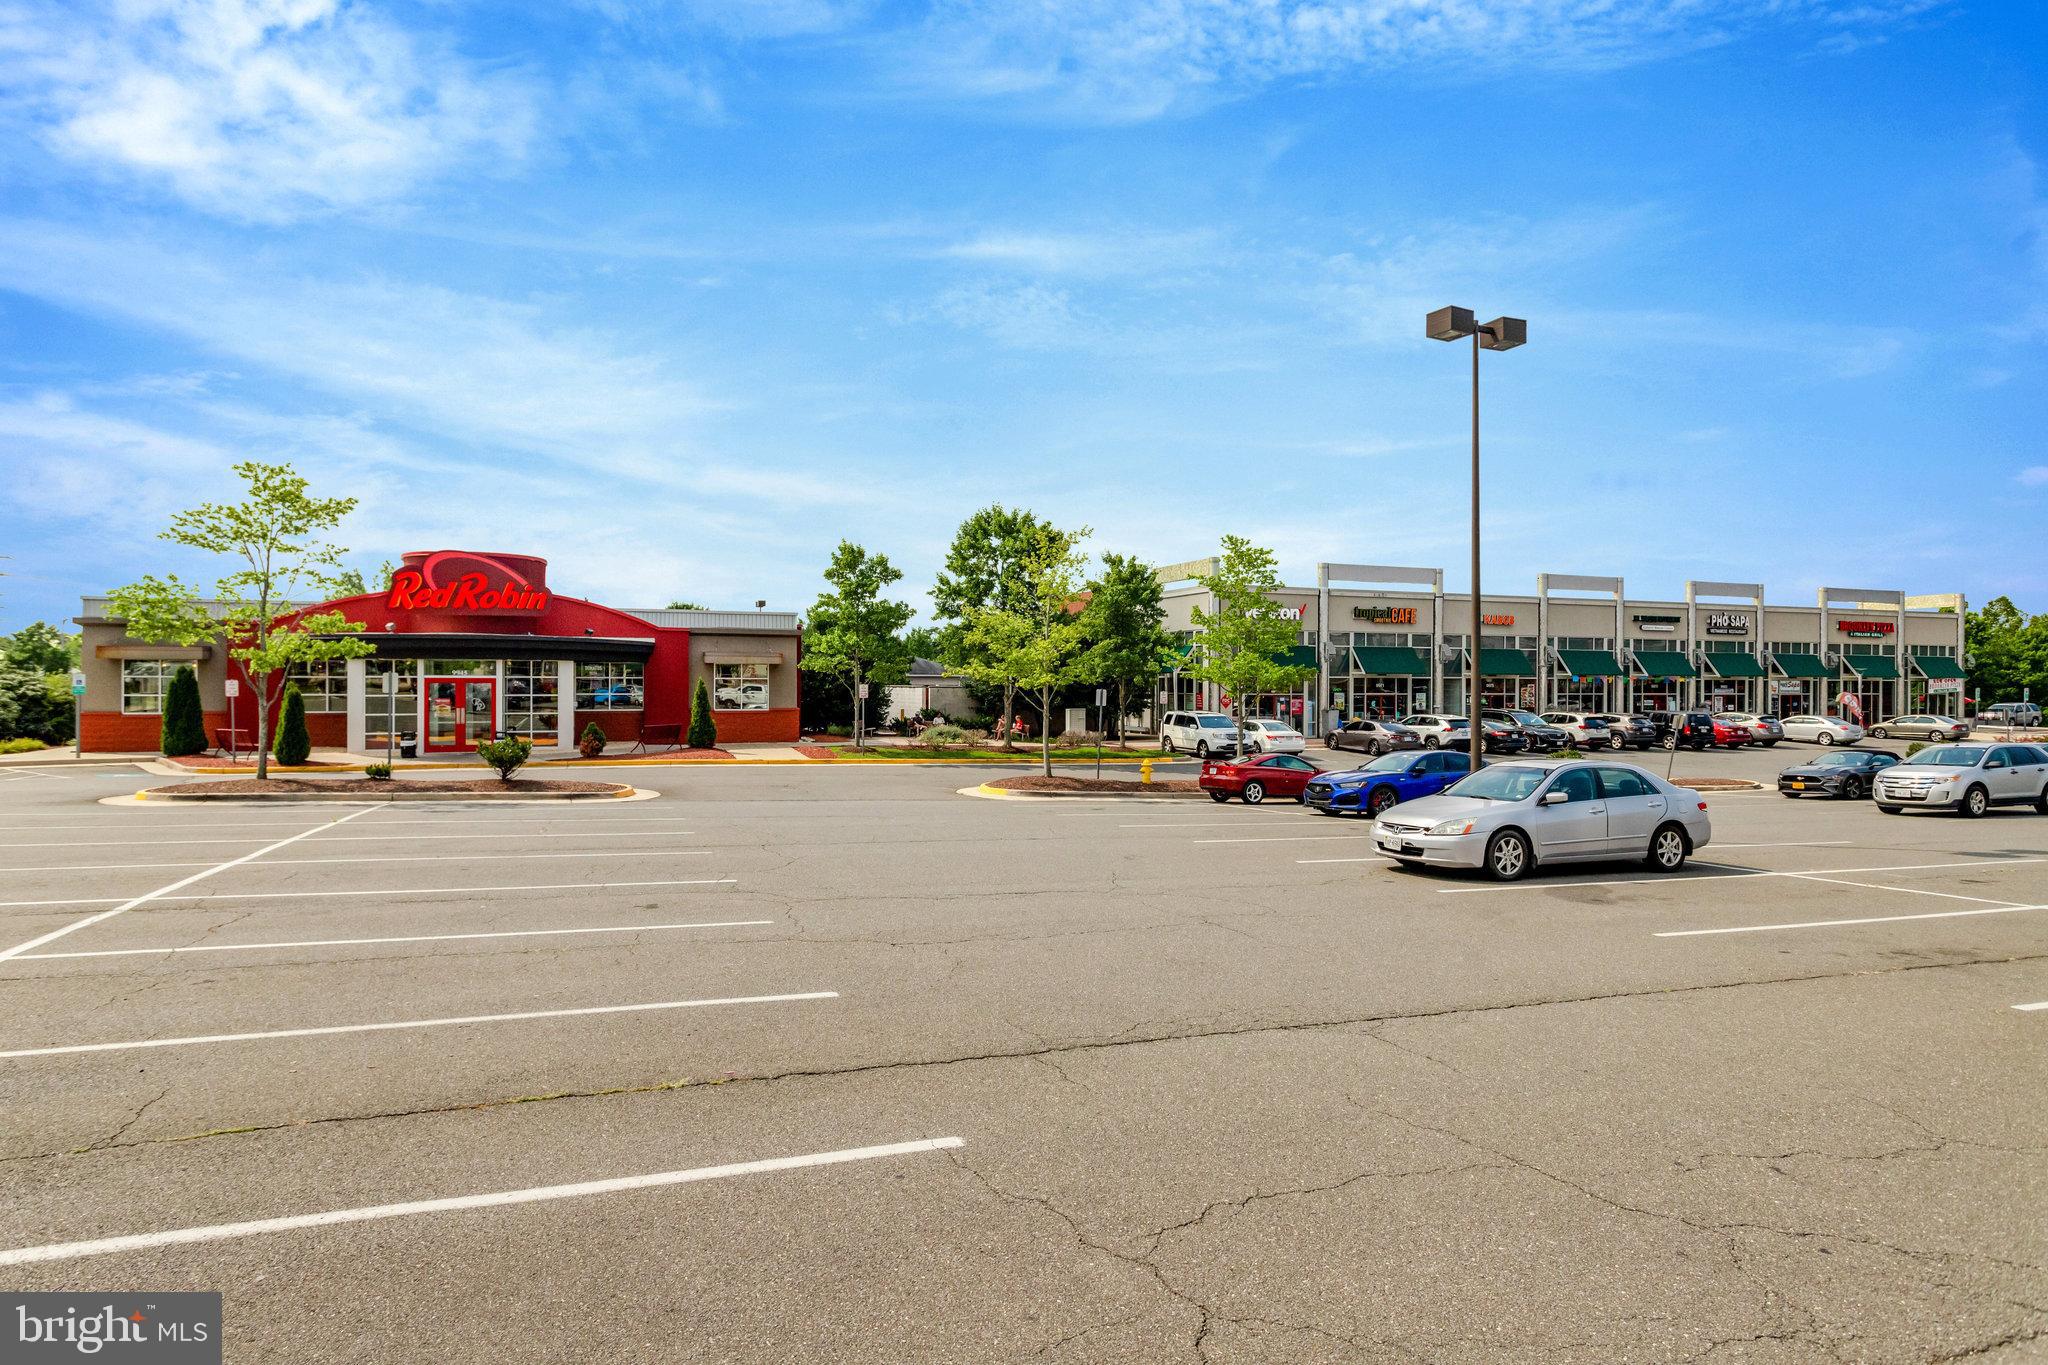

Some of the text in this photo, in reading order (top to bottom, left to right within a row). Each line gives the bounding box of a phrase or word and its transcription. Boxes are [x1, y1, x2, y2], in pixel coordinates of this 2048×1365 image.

[388, 571, 547, 610] Red Robin
[1245, 608, 1300, 620] vezon
[1391, 607, 1417, 624] CAFE
[1731, 615, 1750, 628] SAPA
